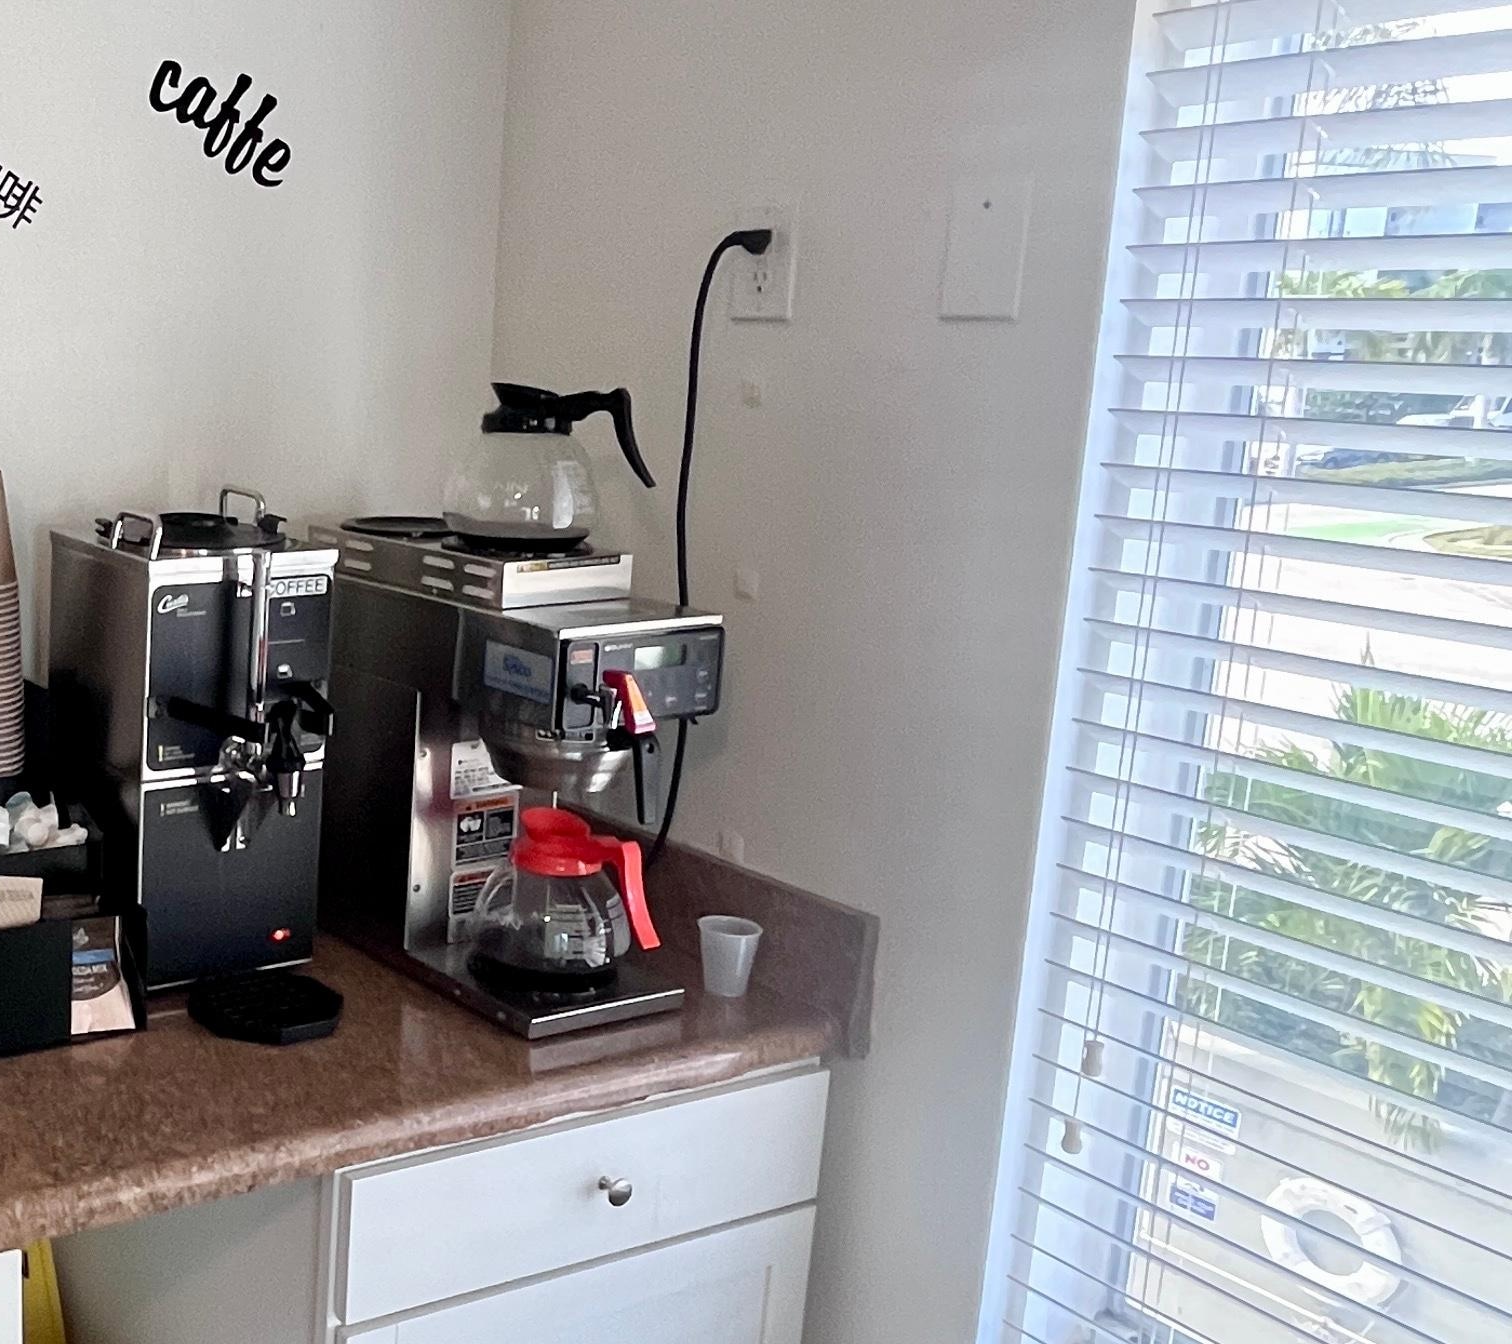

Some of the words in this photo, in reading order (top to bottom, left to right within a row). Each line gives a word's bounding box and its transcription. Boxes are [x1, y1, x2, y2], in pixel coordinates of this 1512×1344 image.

[148, 60, 294, 188] caffe
[1173, 1091, 1237, 1125] NOTICE
[1184, 1154, 1210, 1171] NO
